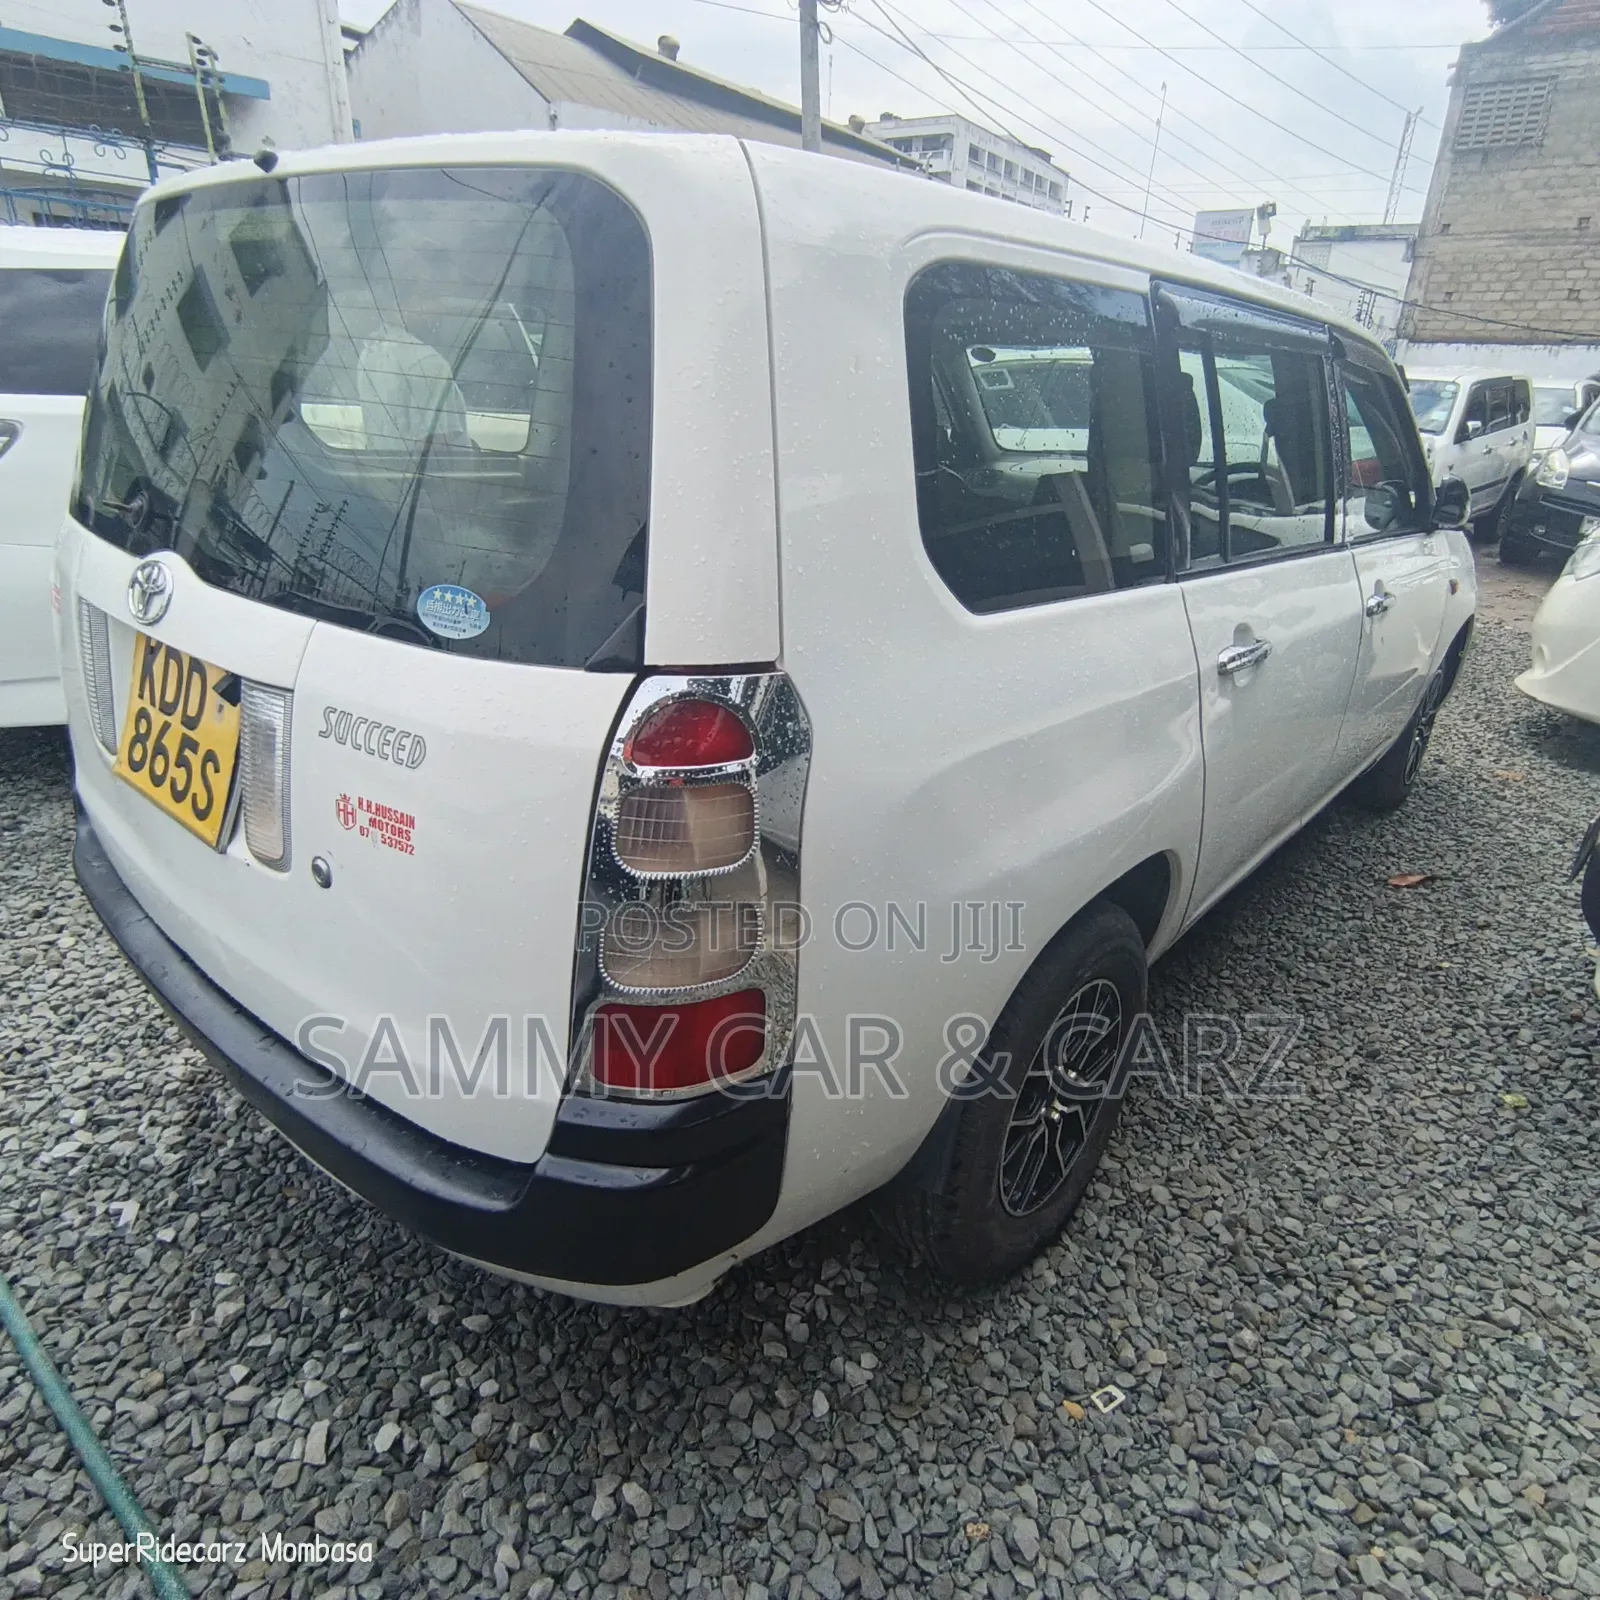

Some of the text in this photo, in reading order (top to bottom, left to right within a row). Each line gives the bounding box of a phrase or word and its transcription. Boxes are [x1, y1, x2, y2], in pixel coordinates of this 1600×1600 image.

[138, 636, 208, 731] KDD
[128, 707, 220, 822] 865S
[318, 705, 427, 770] SUCCEED
[368, 816, 412, 842] MOTORS
